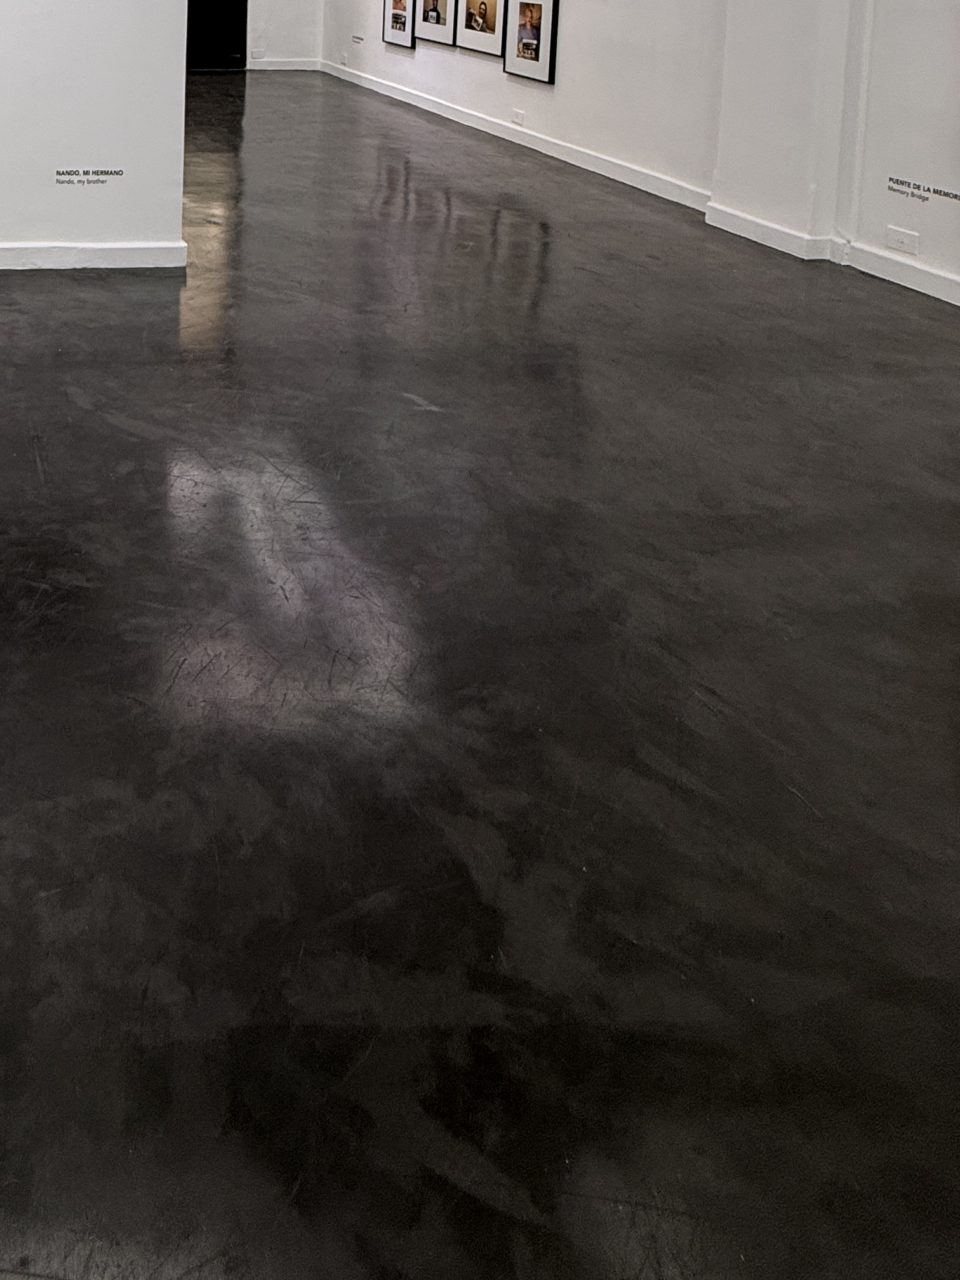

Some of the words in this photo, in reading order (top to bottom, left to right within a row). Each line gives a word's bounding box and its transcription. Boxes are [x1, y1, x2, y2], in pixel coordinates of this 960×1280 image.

[888, 177, 912, 188] PUENTE
[923, 186, 931, 194] LA
[888, 185, 909, 198] Memory
[910, 191, 929, 202] Bridge
